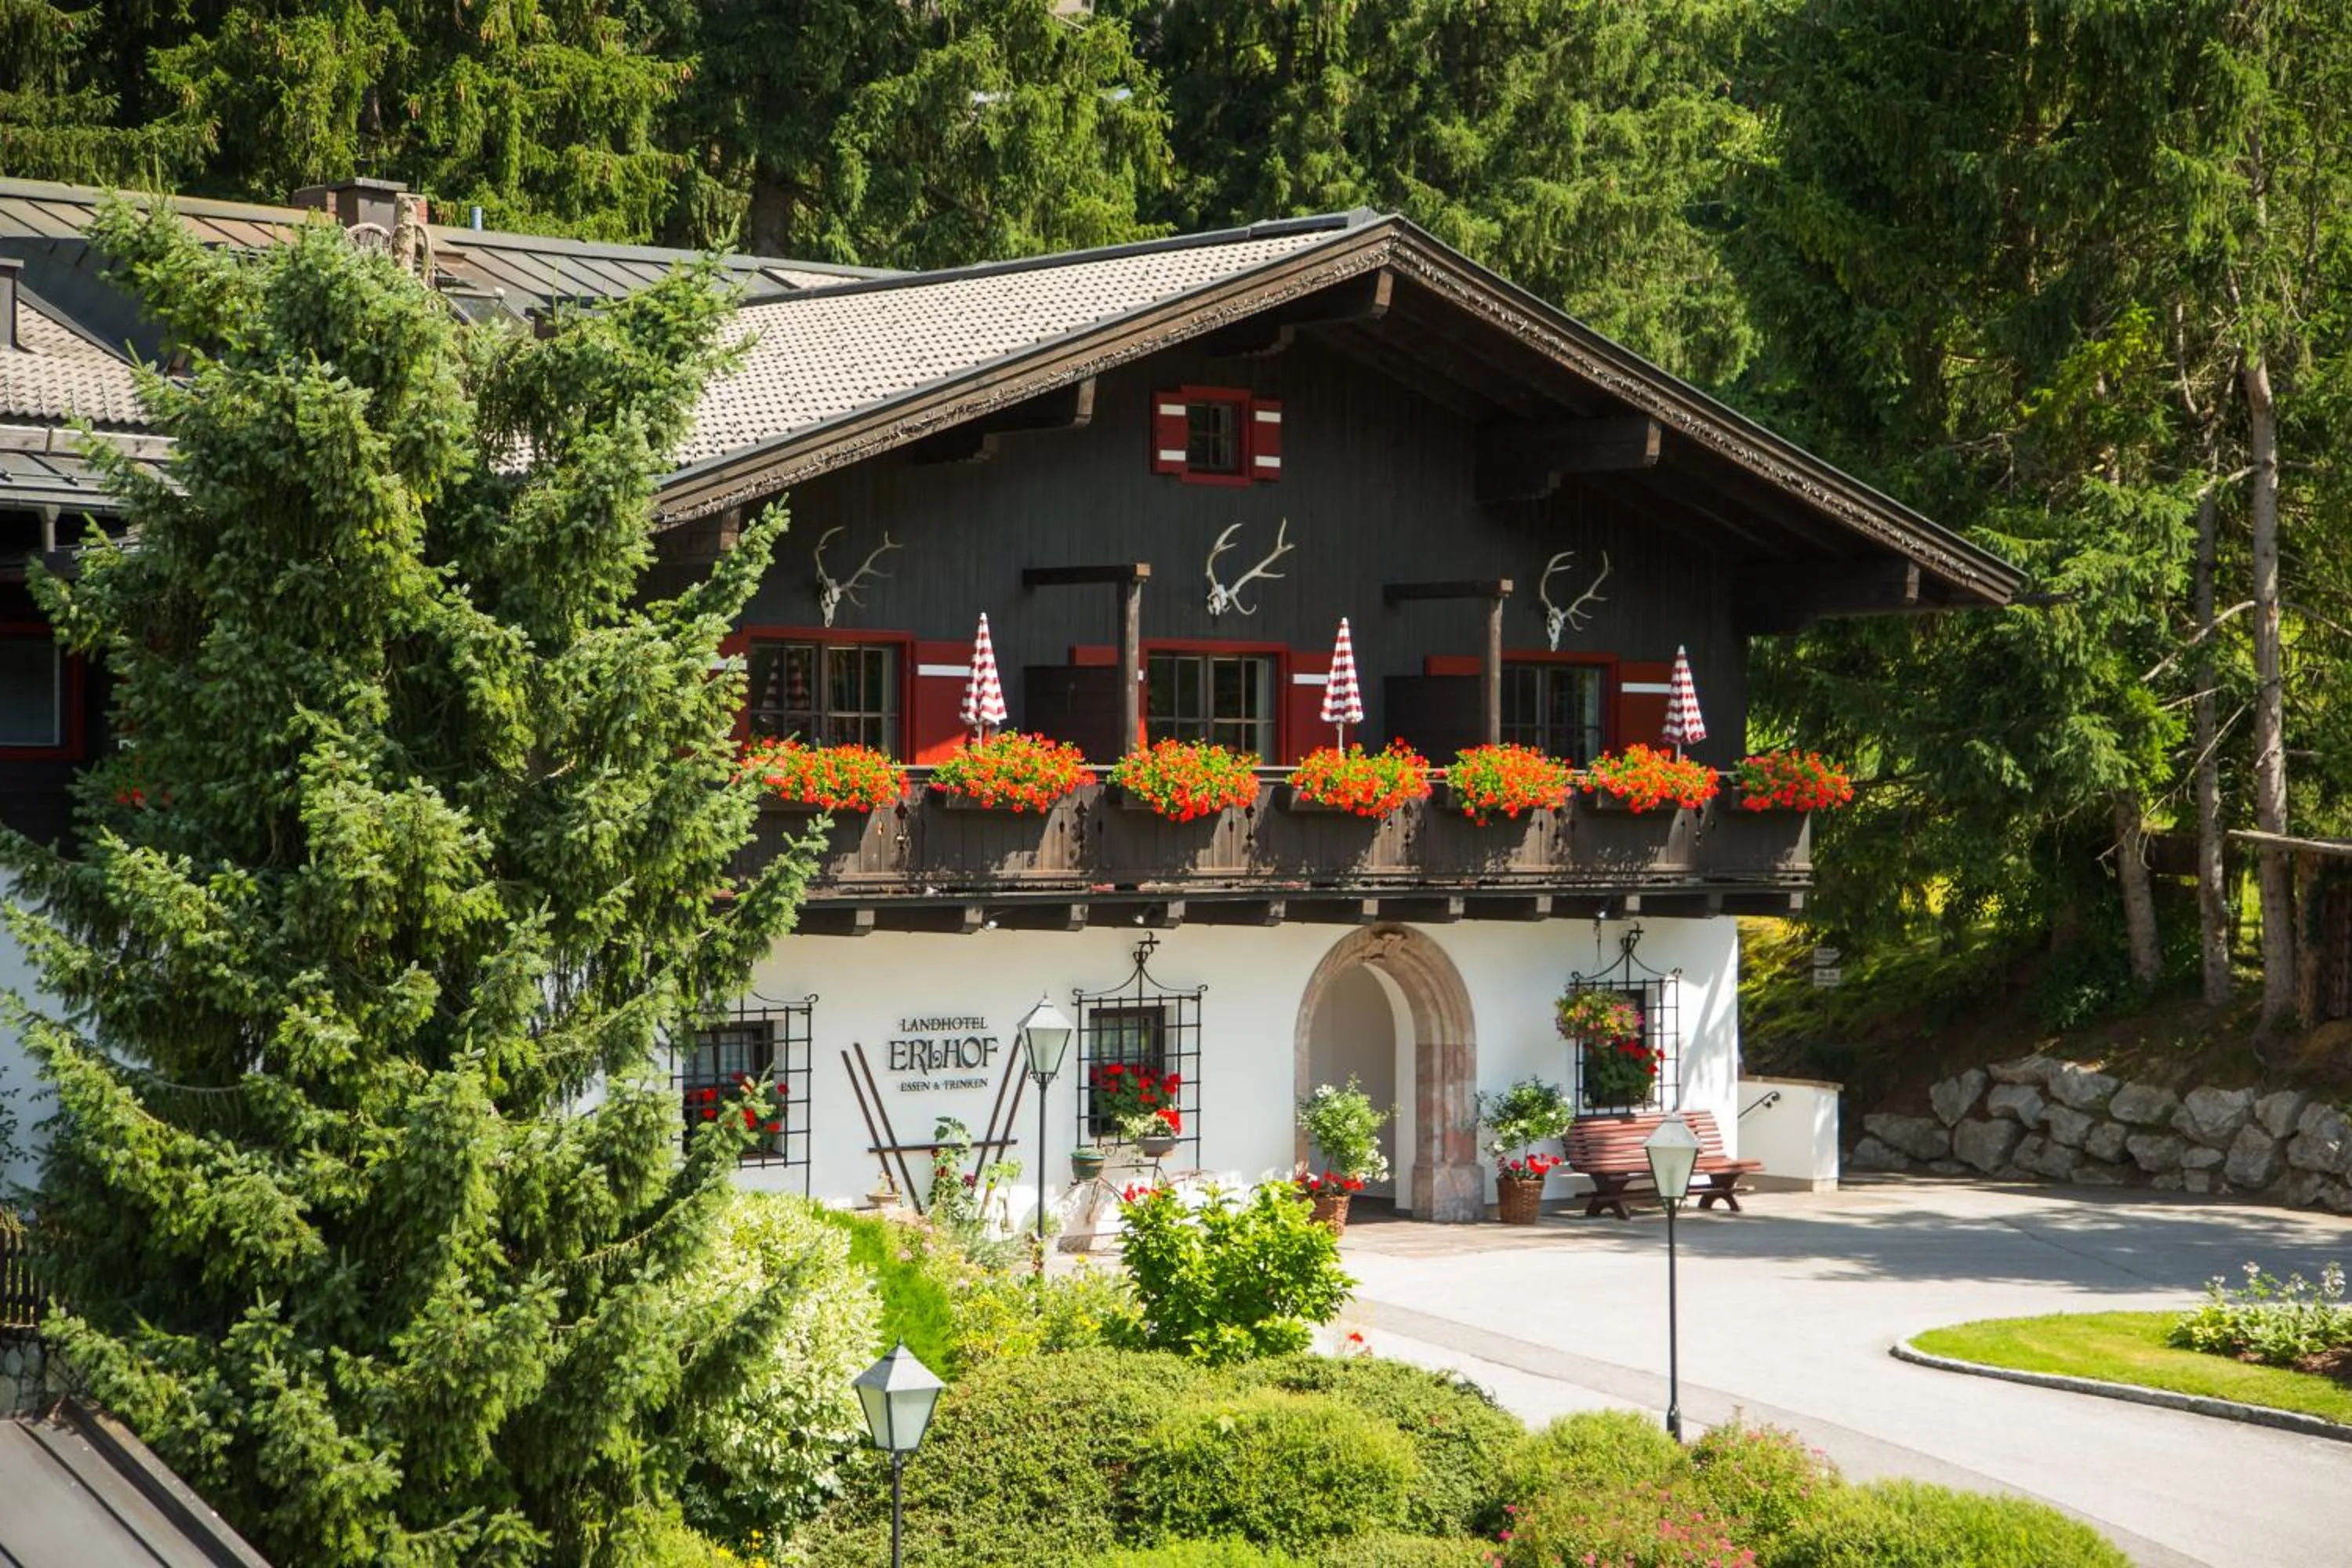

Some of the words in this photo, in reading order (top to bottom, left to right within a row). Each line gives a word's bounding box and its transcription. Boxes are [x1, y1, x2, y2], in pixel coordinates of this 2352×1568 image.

[902, 1017, 988, 1032] LANDHOTEL
[889, 1036, 998, 1076] ERLHOF
[901, 1081, 931, 1091] ESSEN
[933, 1082, 940, 1091] &
[943, 1079, 988, 1091] TRINKEN
